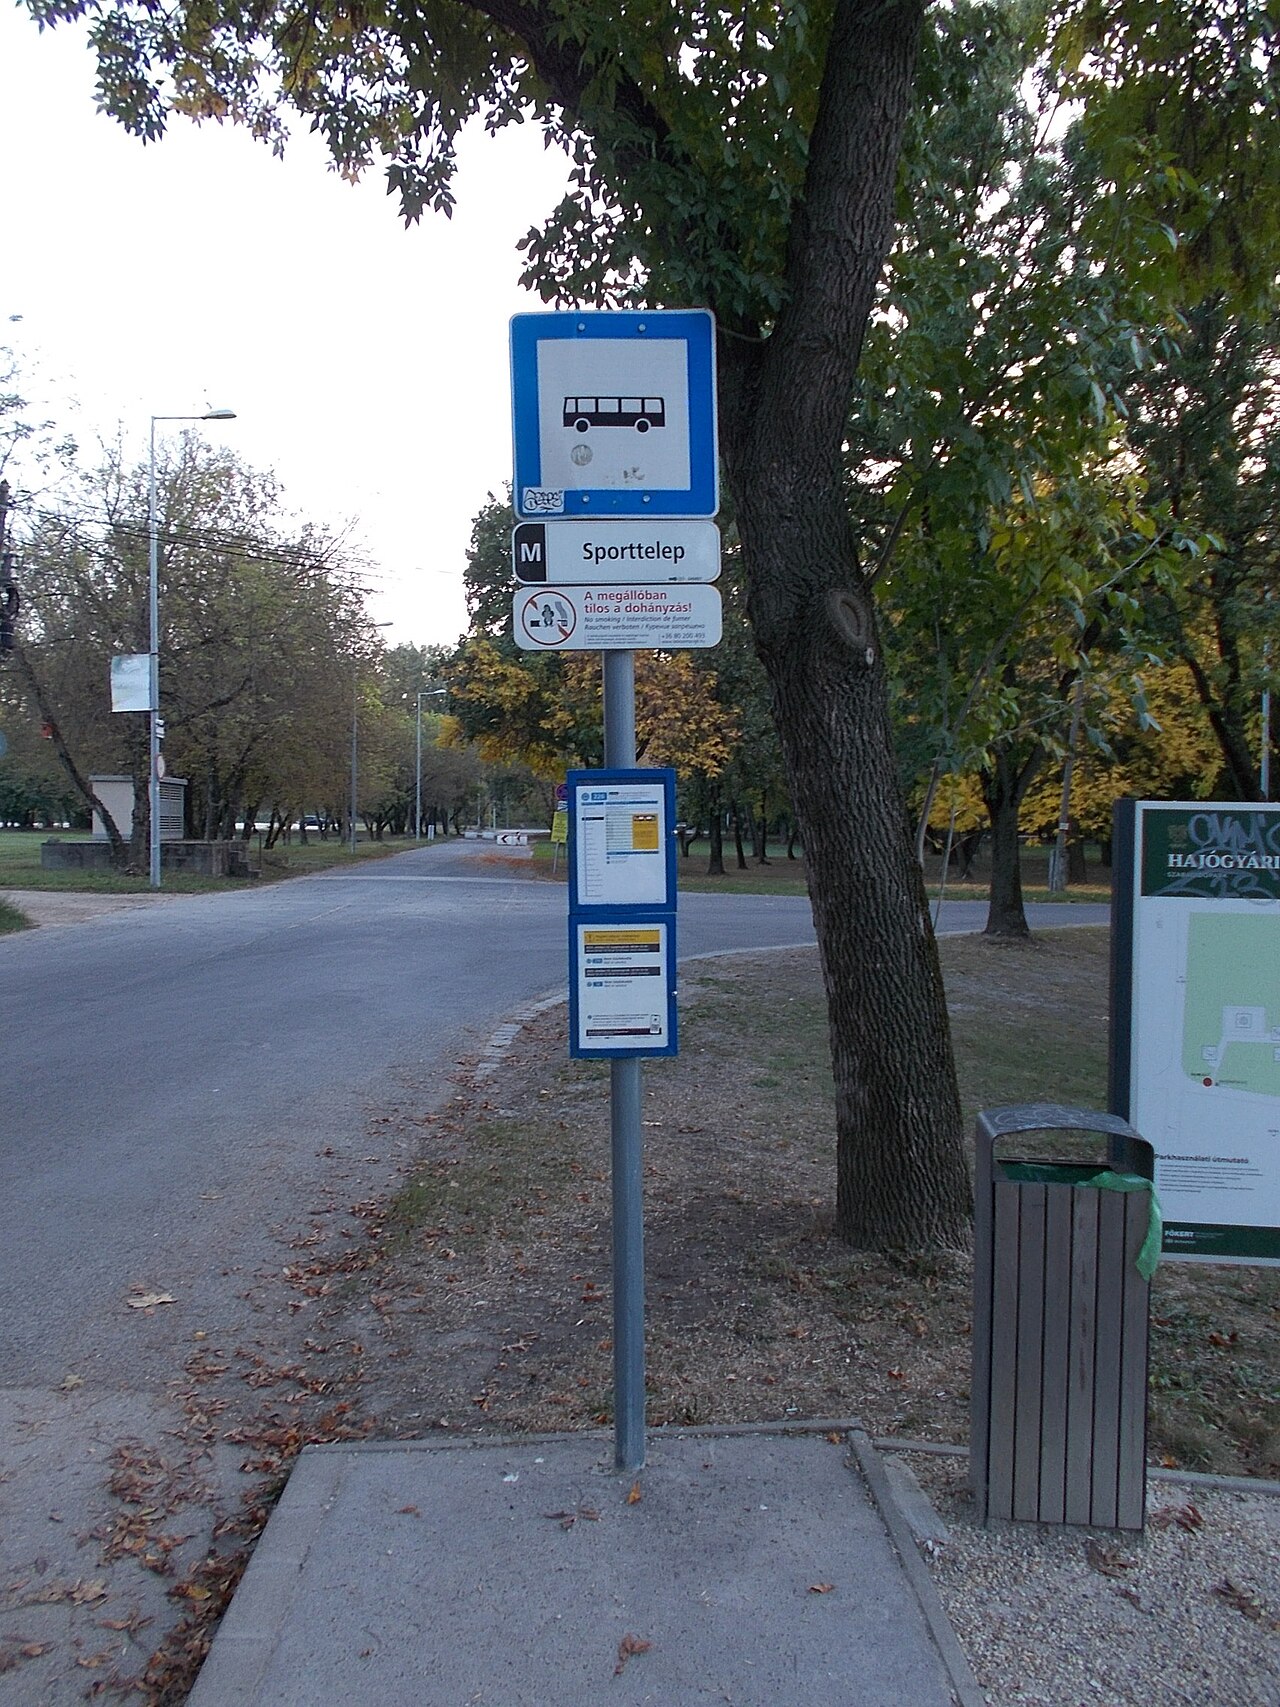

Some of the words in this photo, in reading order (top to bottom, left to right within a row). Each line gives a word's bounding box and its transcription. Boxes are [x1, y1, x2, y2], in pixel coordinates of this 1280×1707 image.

[520, 543, 542, 562] M
[583, 541, 686, 565] Sporttelep
[584, 591, 593, 600] A
[597, 590, 667, 603] megállóban
[584, 603, 610, 613] tilos
[614, 605, 621, 613] a
[624, 602, 692, 615] dohányzás!
[595, 616, 621, 624] smoking
[1167, 850, 1280, 870] HAJÓGYÁRI
